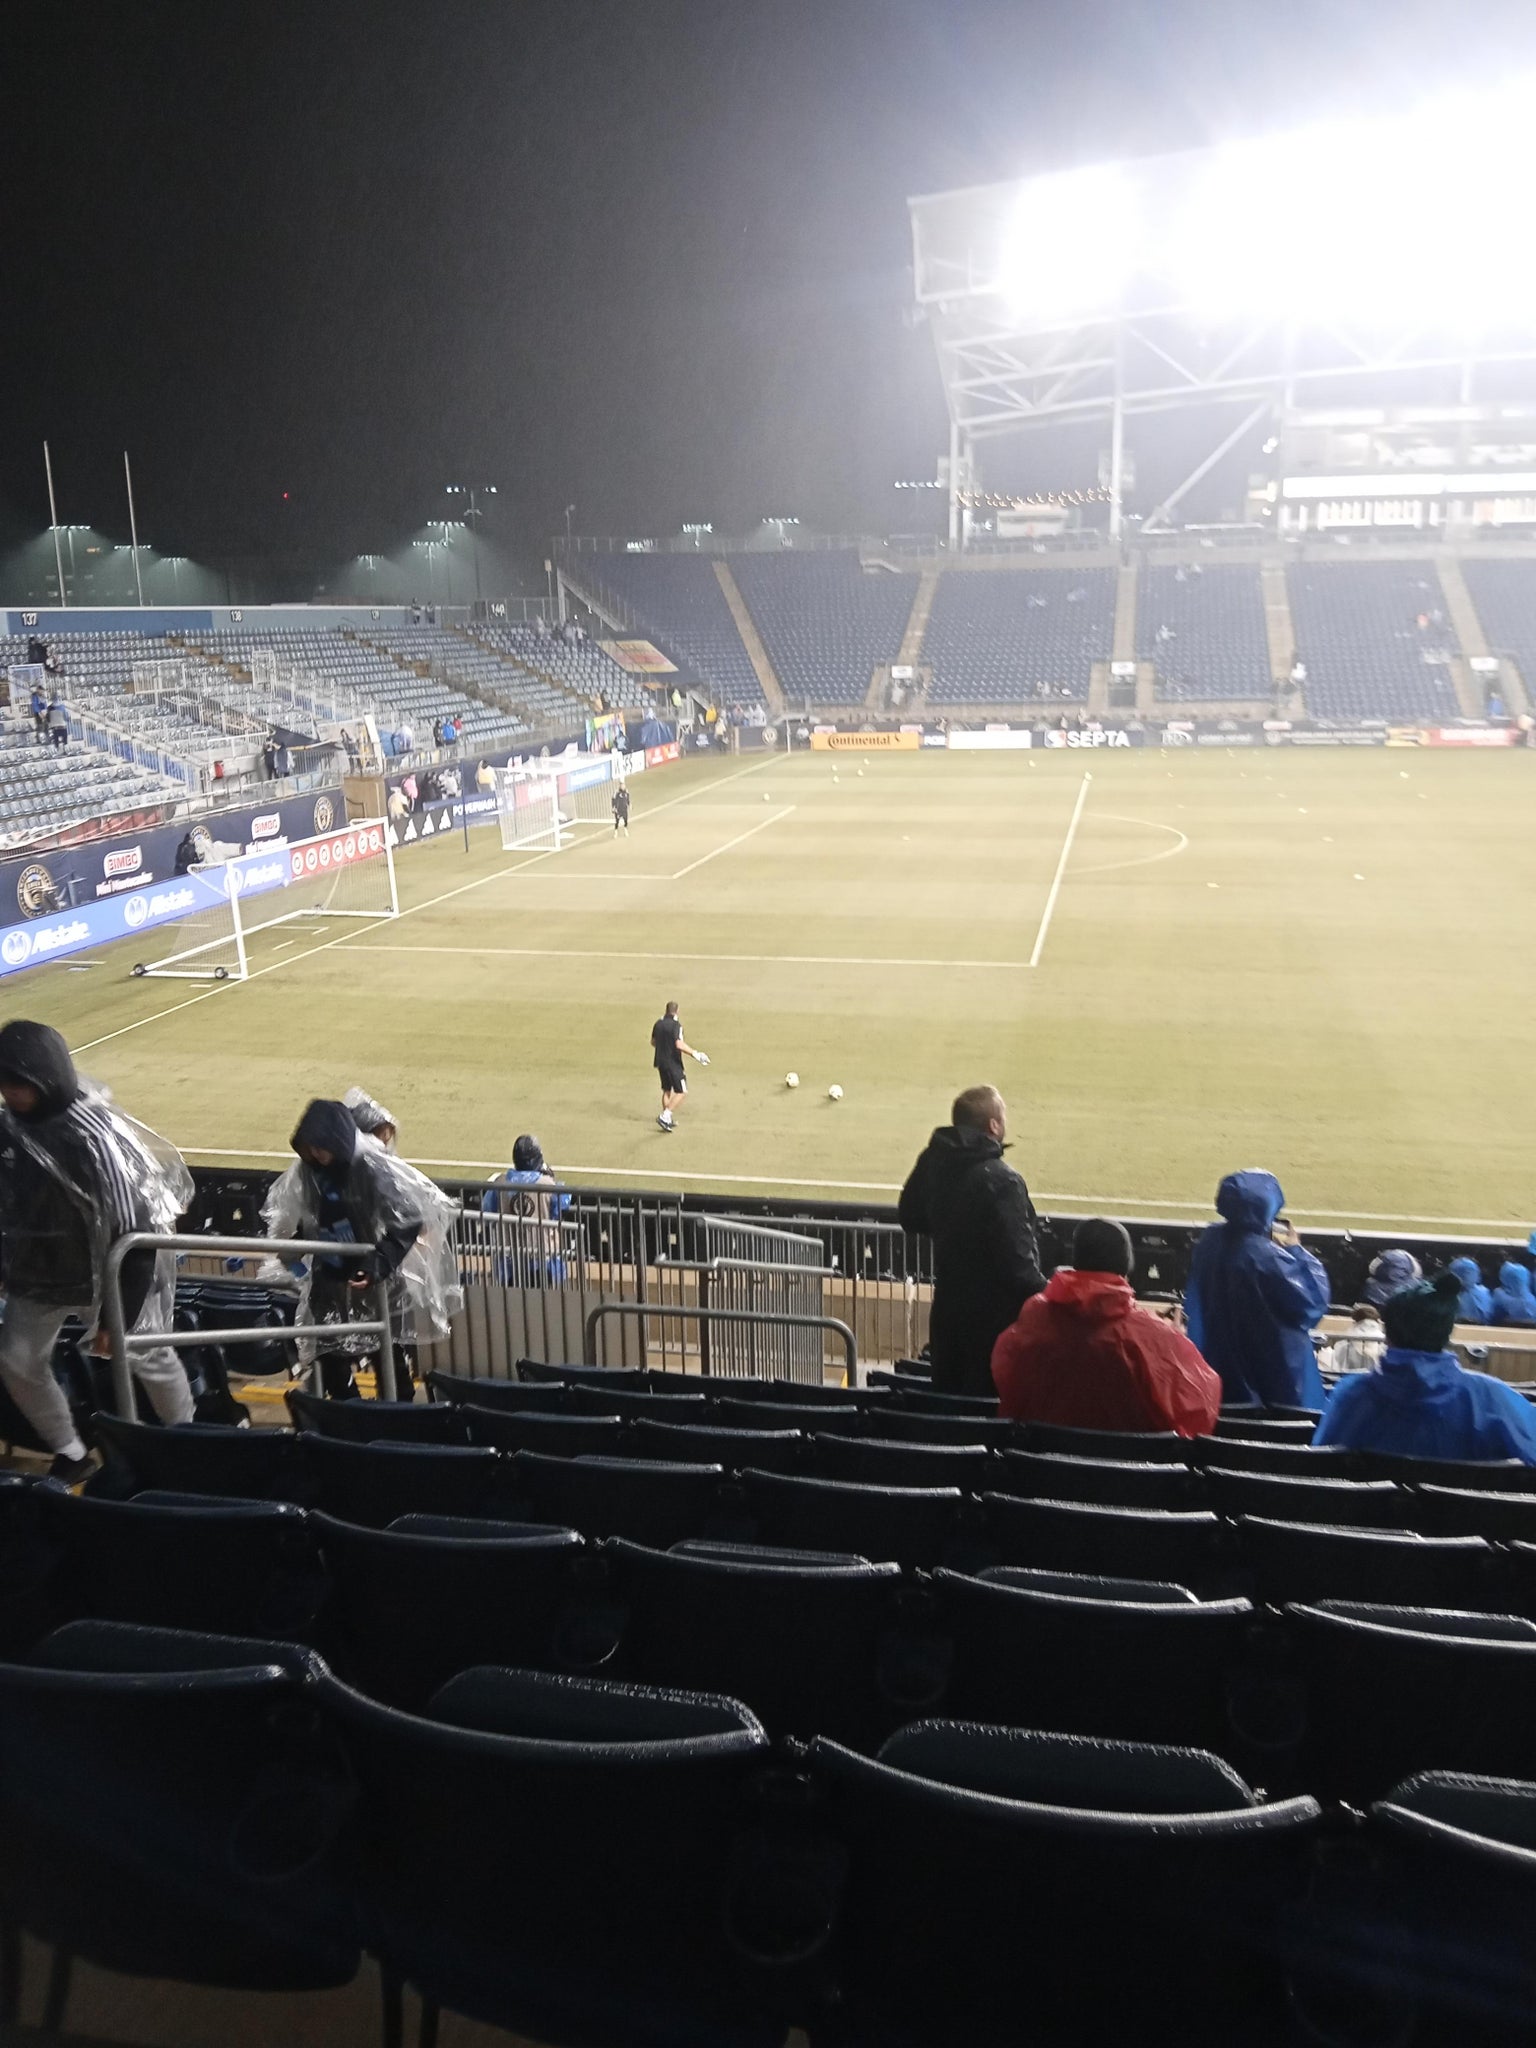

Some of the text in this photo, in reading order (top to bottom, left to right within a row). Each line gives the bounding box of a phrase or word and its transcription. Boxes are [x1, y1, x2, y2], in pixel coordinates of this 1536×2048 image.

[22, 612, 37, 626] 137
[828, 734, 890, 749] Continental
[1067, 730, 1131, 747] SEPTA
[107, 852, 139, 871] BIMBO
[148, 888, 196, 918] Allstate
[32, 920, 92, 954] Allstate
